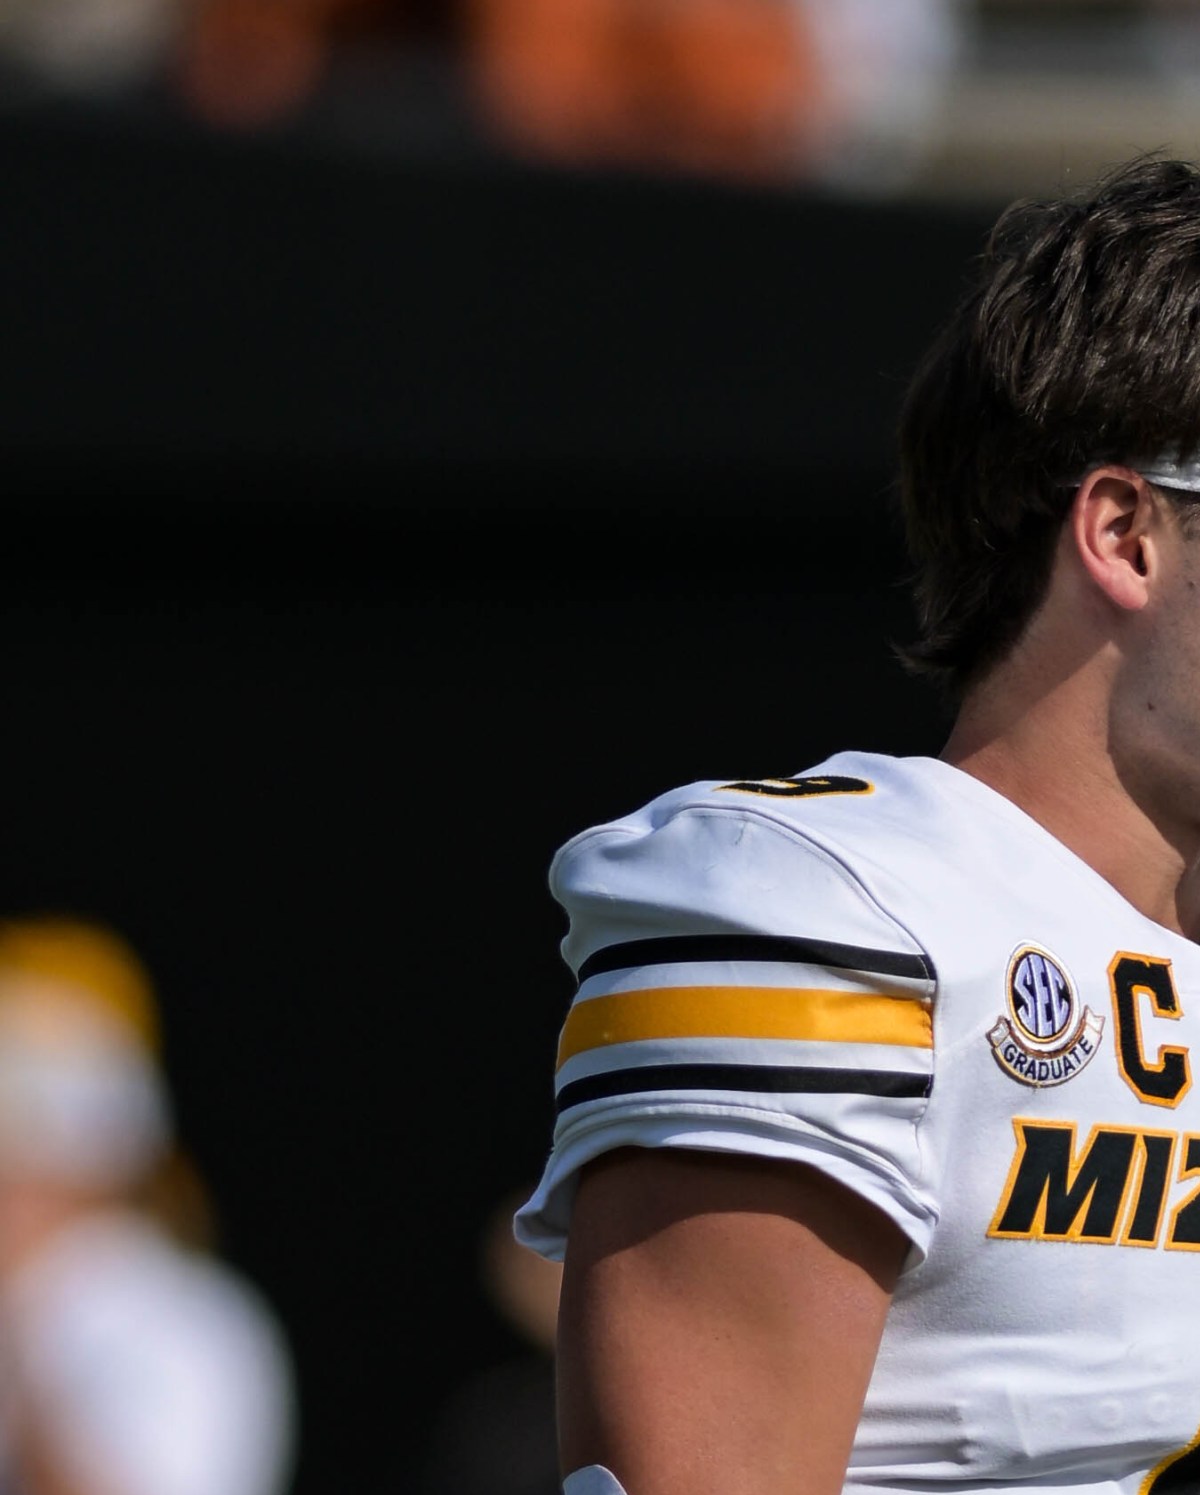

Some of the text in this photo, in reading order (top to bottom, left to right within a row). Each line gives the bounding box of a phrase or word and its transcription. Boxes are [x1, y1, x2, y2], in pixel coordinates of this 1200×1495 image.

[1014, 953, 1071, 1037] SEC
[1107, 950, 1192, 1108] C
[1003, 1035, 1094, 1081] GRADUATE
